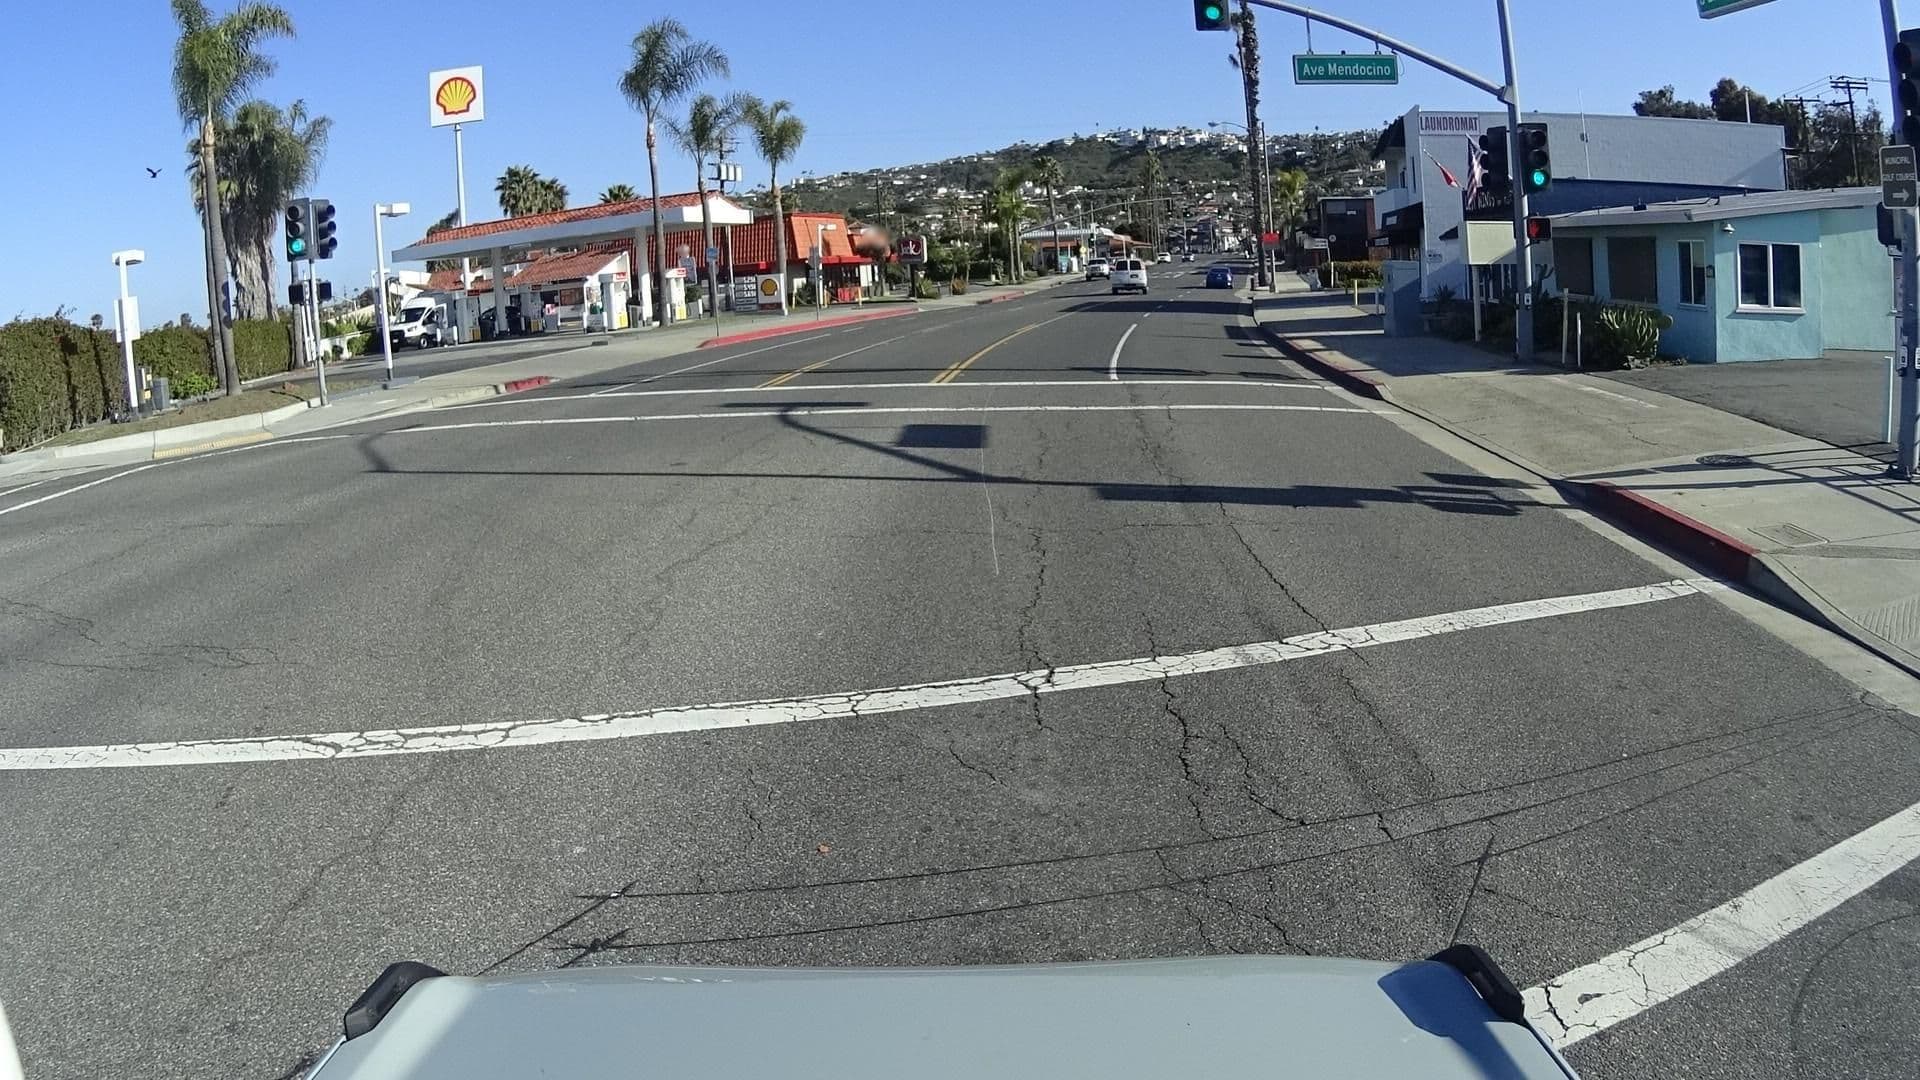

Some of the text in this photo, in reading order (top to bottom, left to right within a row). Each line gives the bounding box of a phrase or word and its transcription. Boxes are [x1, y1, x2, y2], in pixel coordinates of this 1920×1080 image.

[1303, 63, 1391, 76] Ave Mendocino
[1420, 116, 1478, 131] LAUNDROMAT
